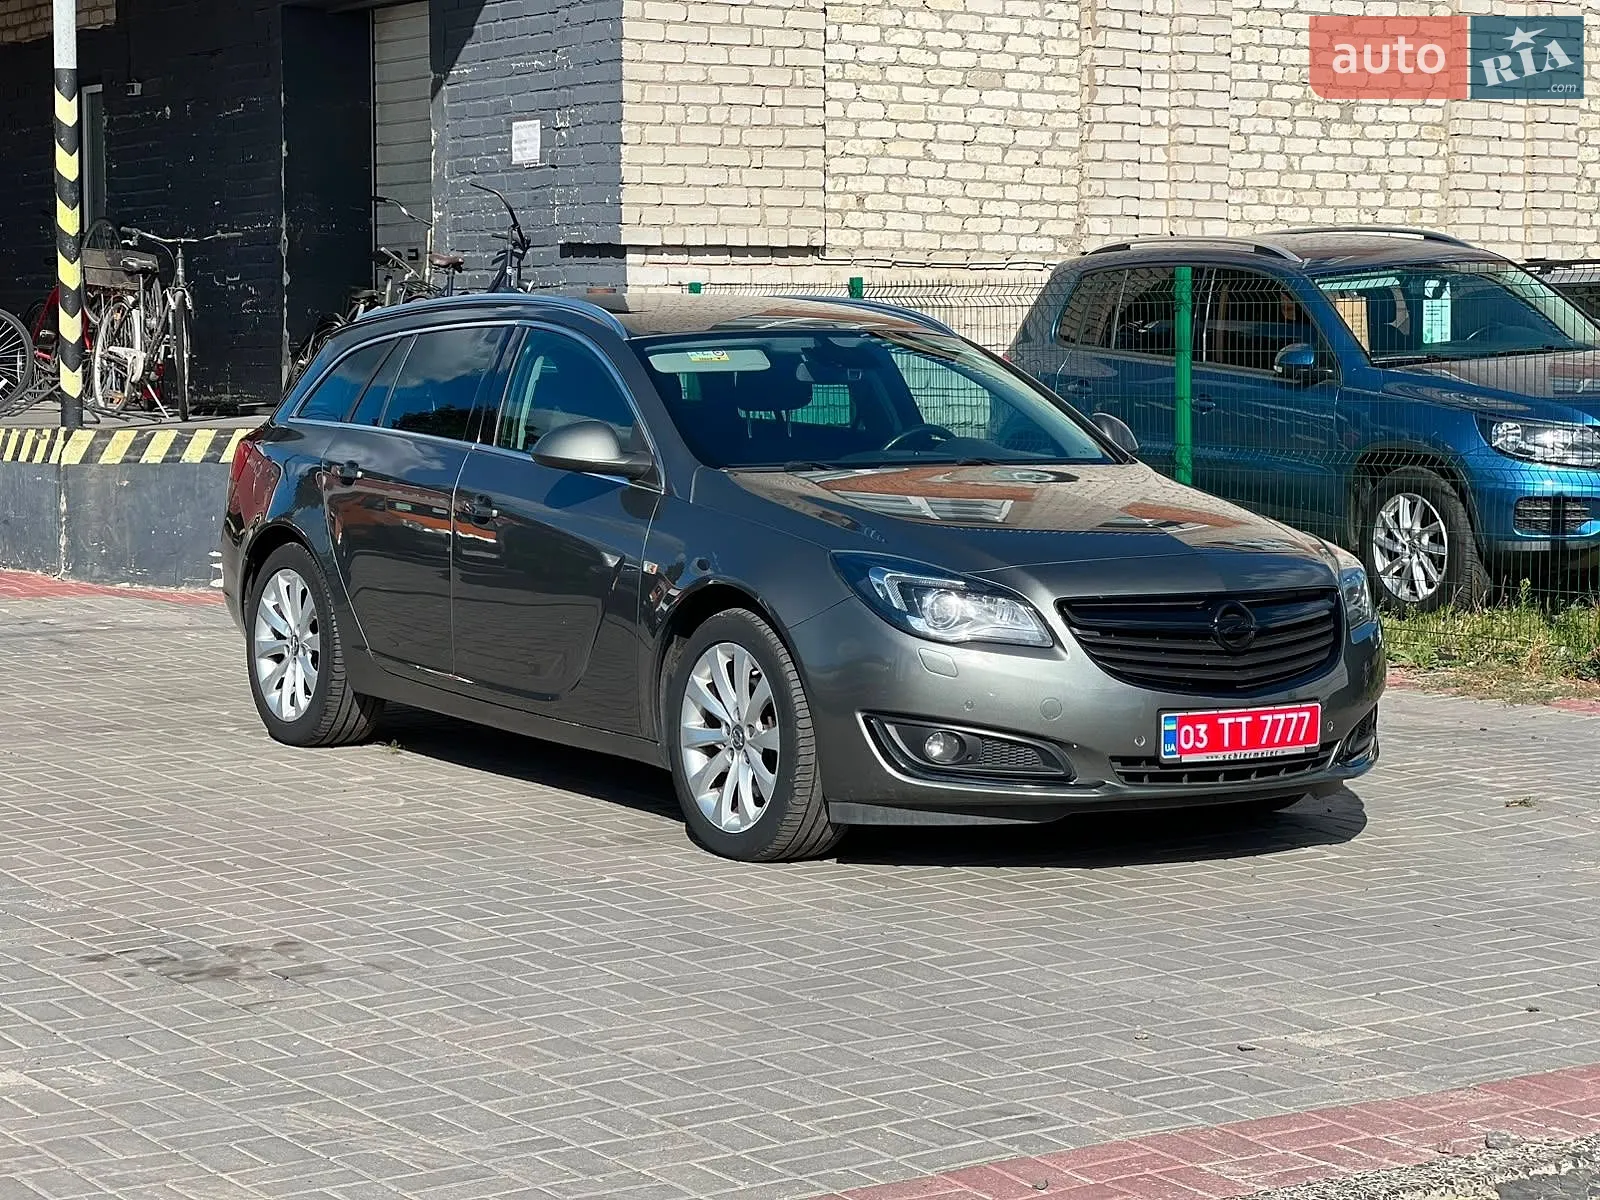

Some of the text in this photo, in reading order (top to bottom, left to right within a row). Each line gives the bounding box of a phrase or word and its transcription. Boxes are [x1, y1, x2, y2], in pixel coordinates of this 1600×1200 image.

[1179, 711, 1311, 749] 03 TT 7777
[1164, 744, 1176, 752] UA
